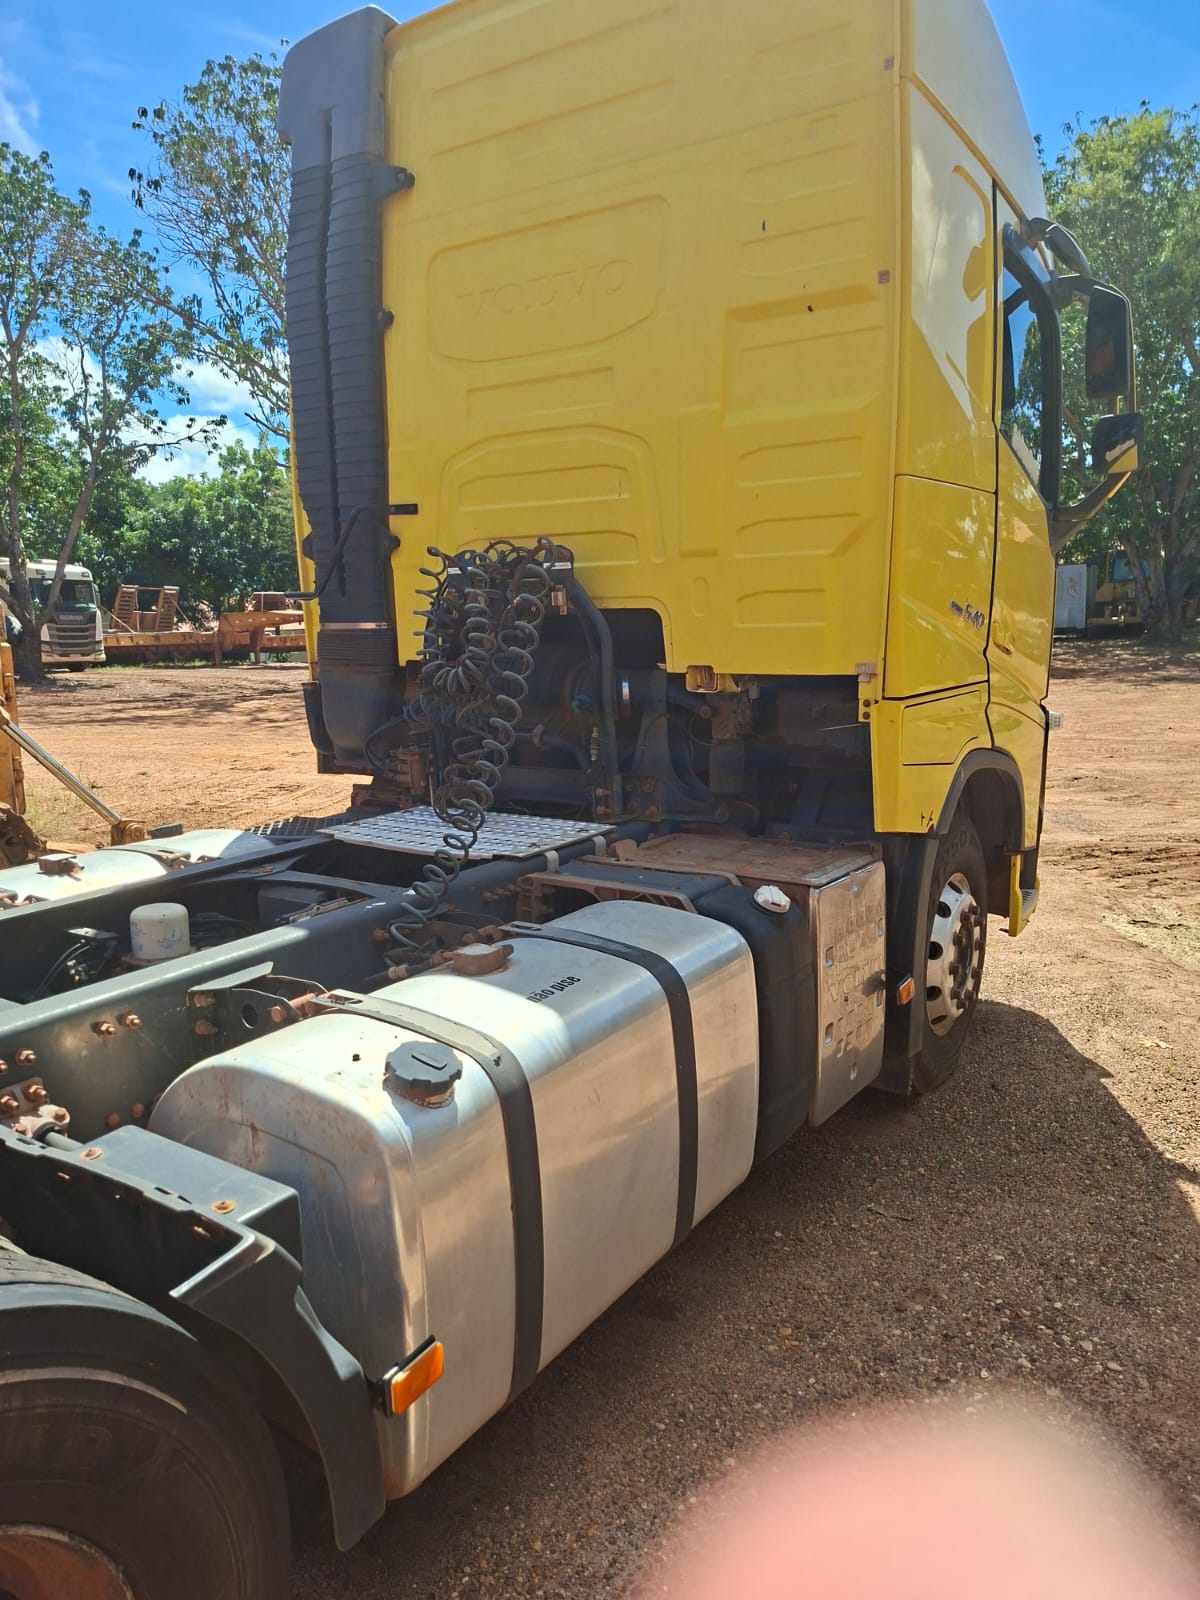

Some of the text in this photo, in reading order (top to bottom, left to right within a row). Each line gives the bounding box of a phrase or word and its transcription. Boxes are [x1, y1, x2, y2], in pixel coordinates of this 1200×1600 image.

[963, 602, 986, 631] 540
[526, 975, 582, 1004] não pise
